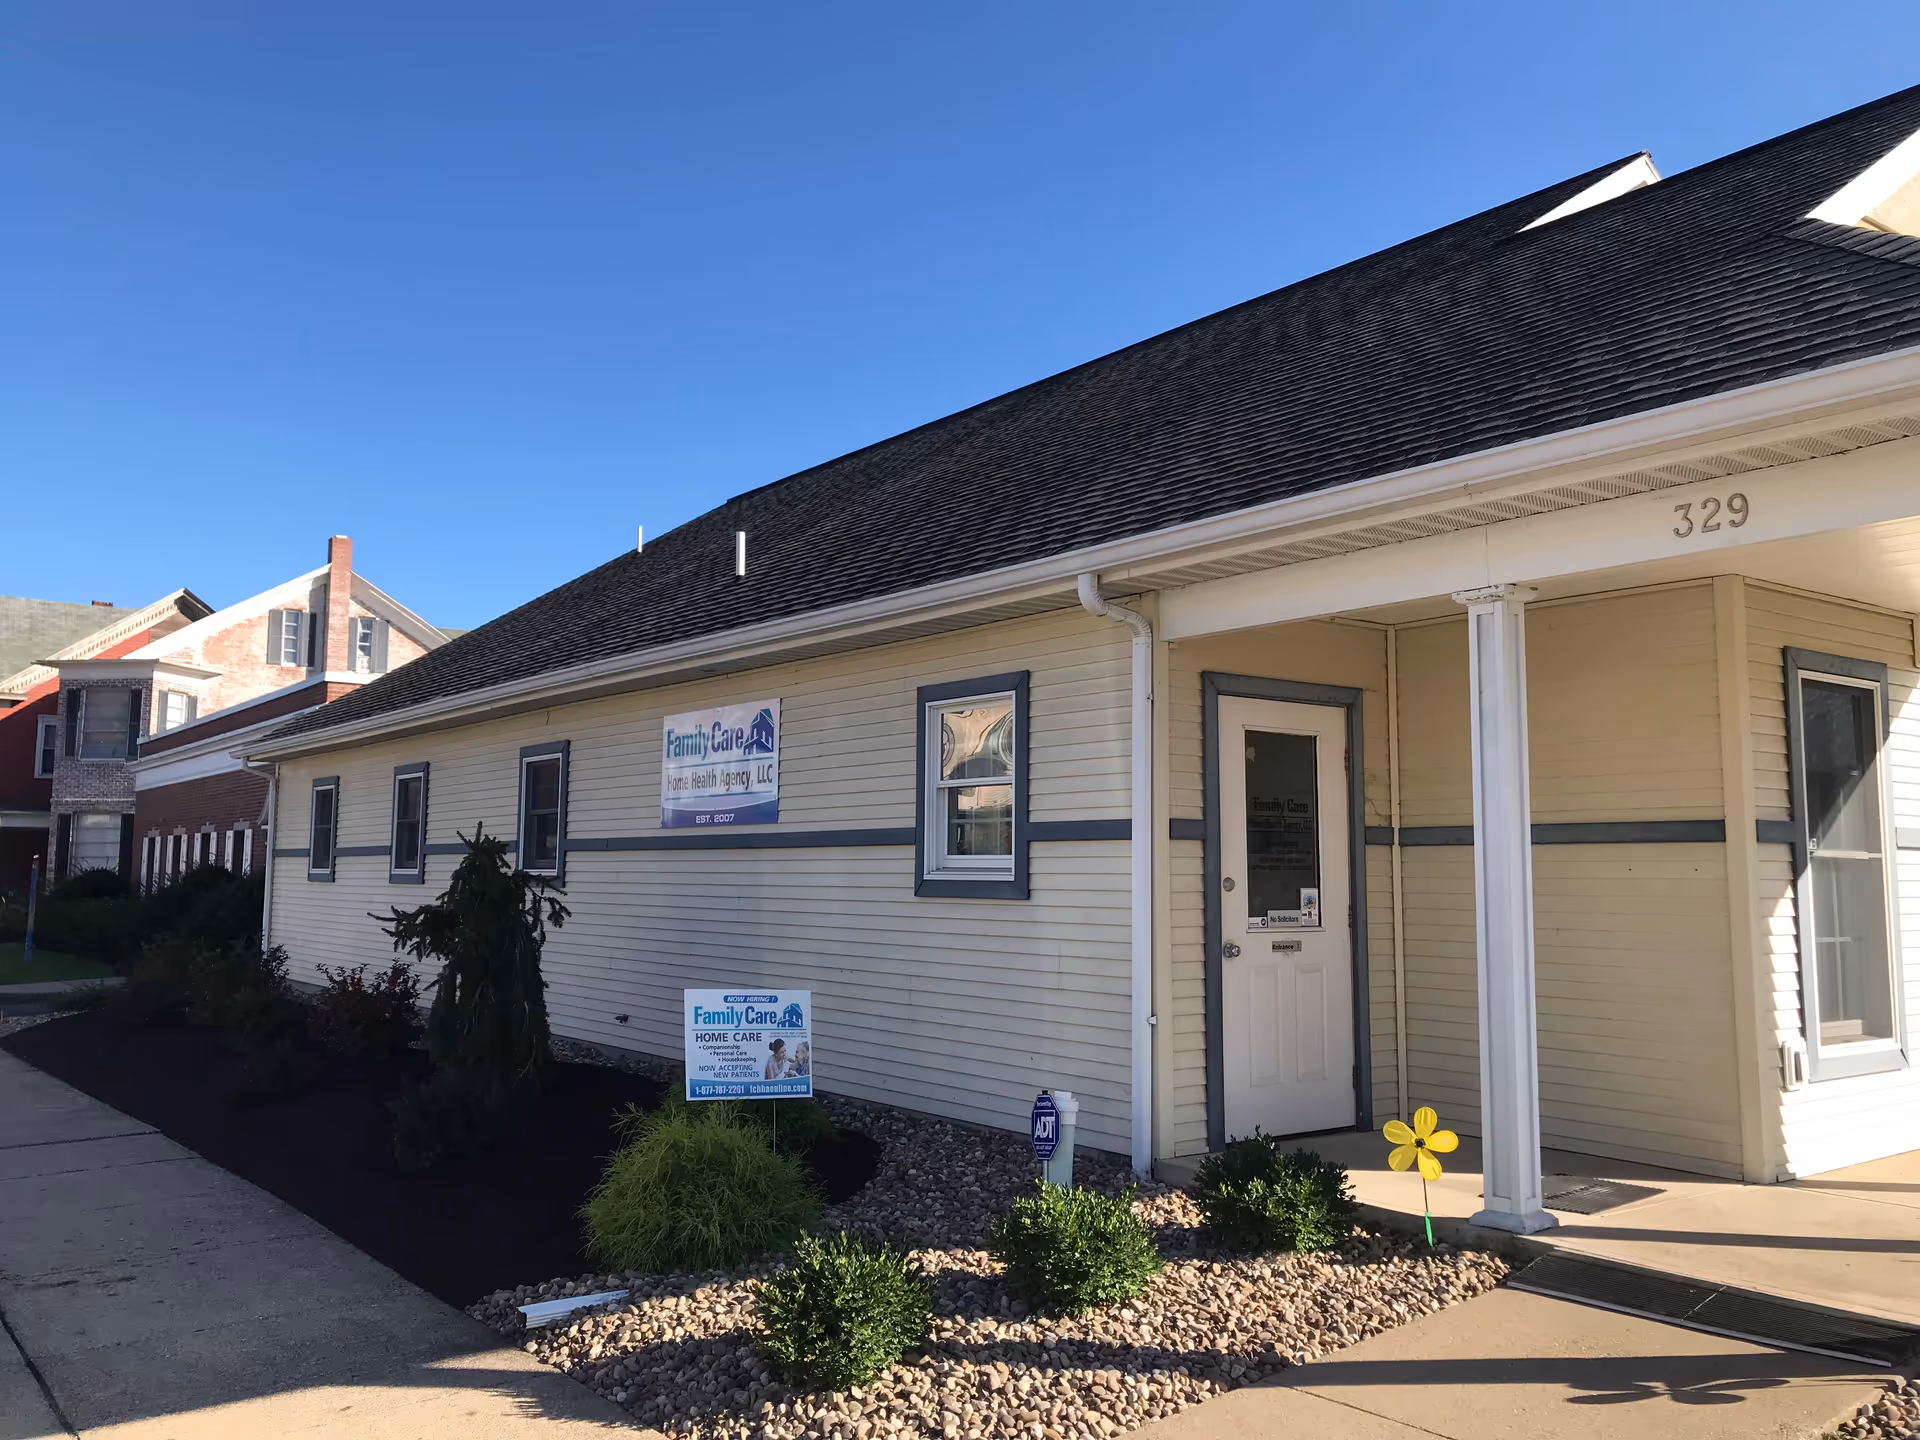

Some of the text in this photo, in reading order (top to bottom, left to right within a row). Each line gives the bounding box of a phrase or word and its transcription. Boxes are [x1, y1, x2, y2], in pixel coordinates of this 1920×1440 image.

[1673, 493, 1749, 538] 329
[667, 763, 773, 791] Home Health Agency, LLC
[695, 814, 735, 823] EST. 2007
[1278, 915, 1299, 923] Solicitors
[1271, 943, 1294, 951] Entrance
[695, 1032, 762, 1043] HOME CARE
[1034, 1116, 1056, 1139] ADT
